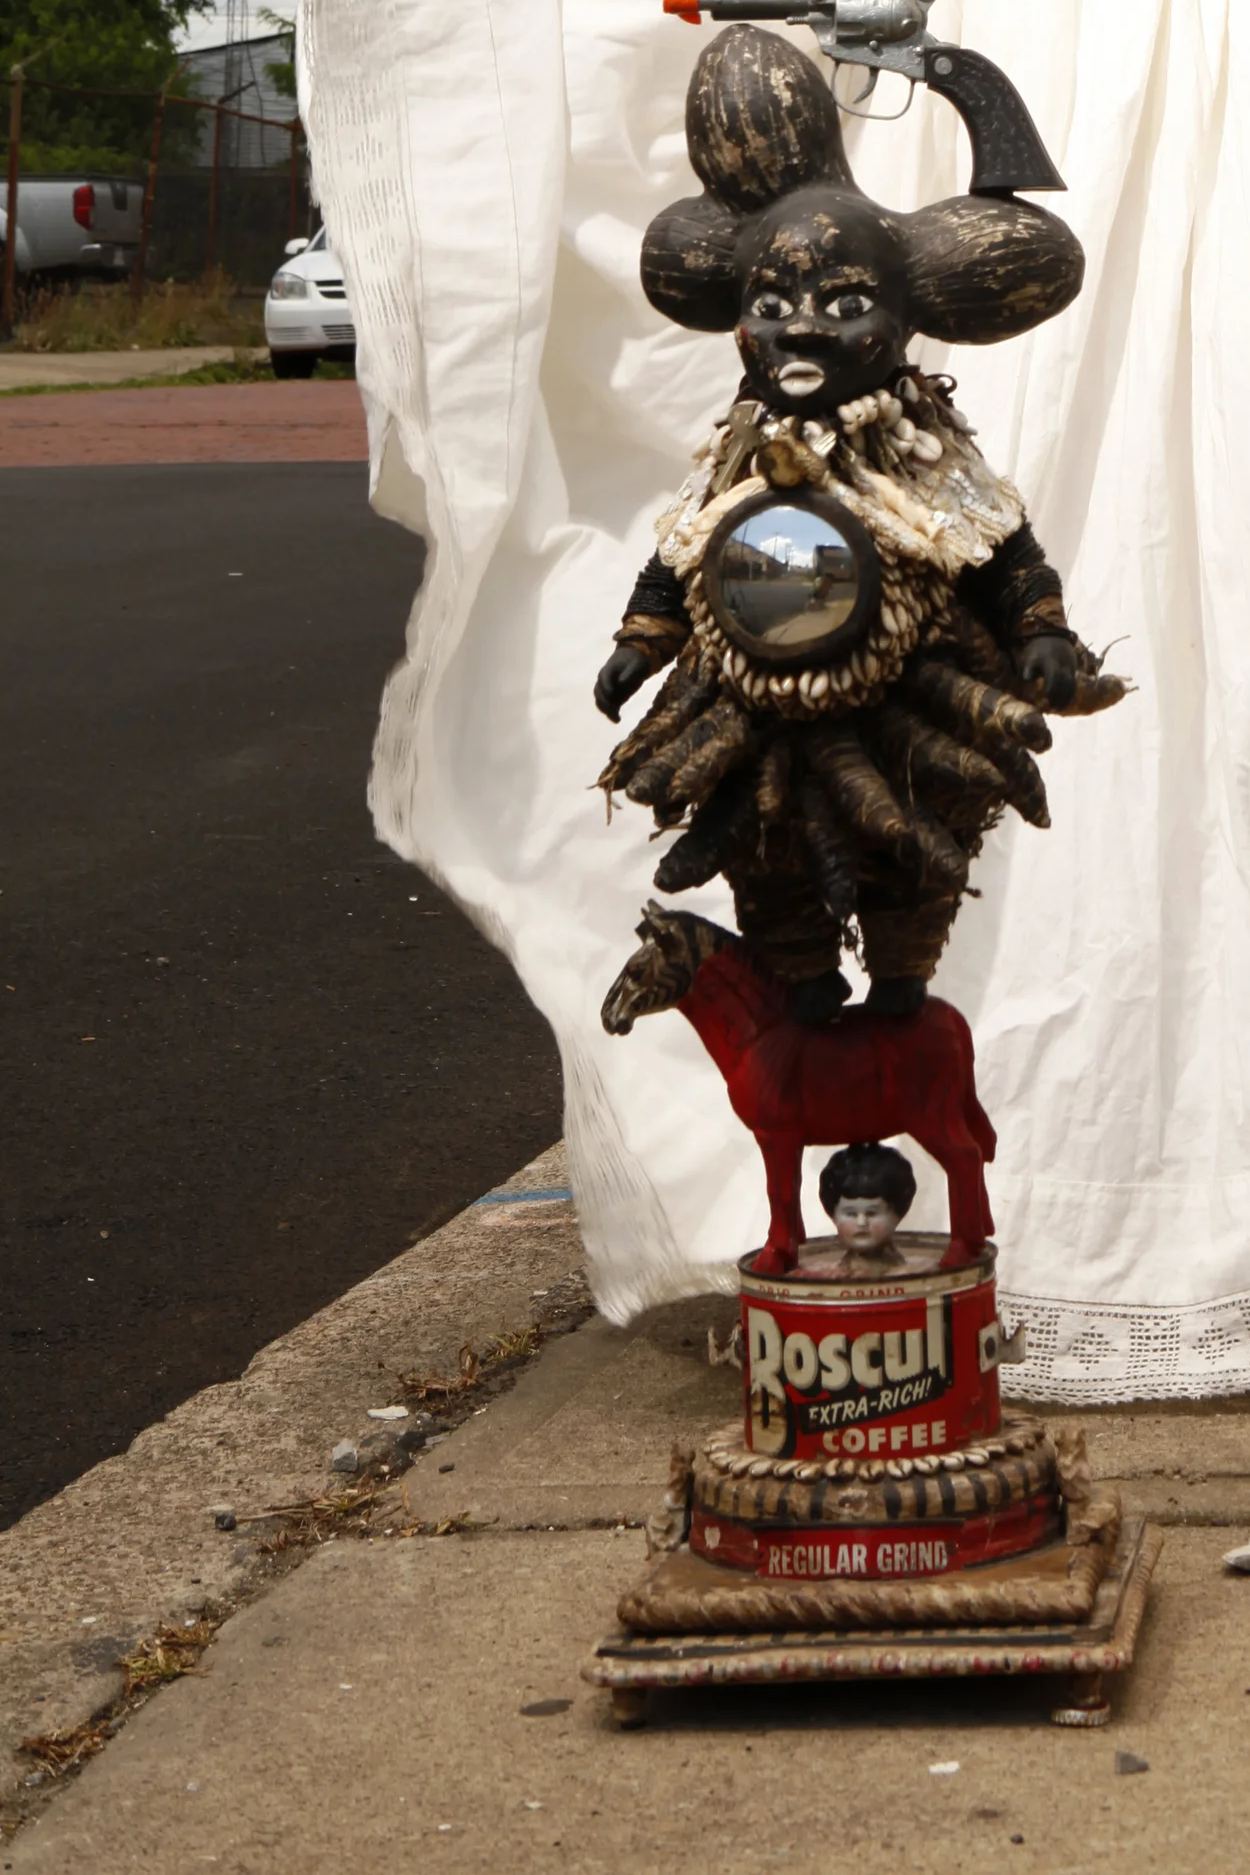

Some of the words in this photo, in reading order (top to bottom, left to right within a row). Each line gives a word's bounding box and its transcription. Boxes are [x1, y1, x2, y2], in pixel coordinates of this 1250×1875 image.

[808, 1376, 933, 1426] EXTRA-RICH!
[822, 1420, 947, 1454] COFFEE
[768, 1543, 868, 1575] REGULAR
[876, 1540, 949, 1573] GRIND
